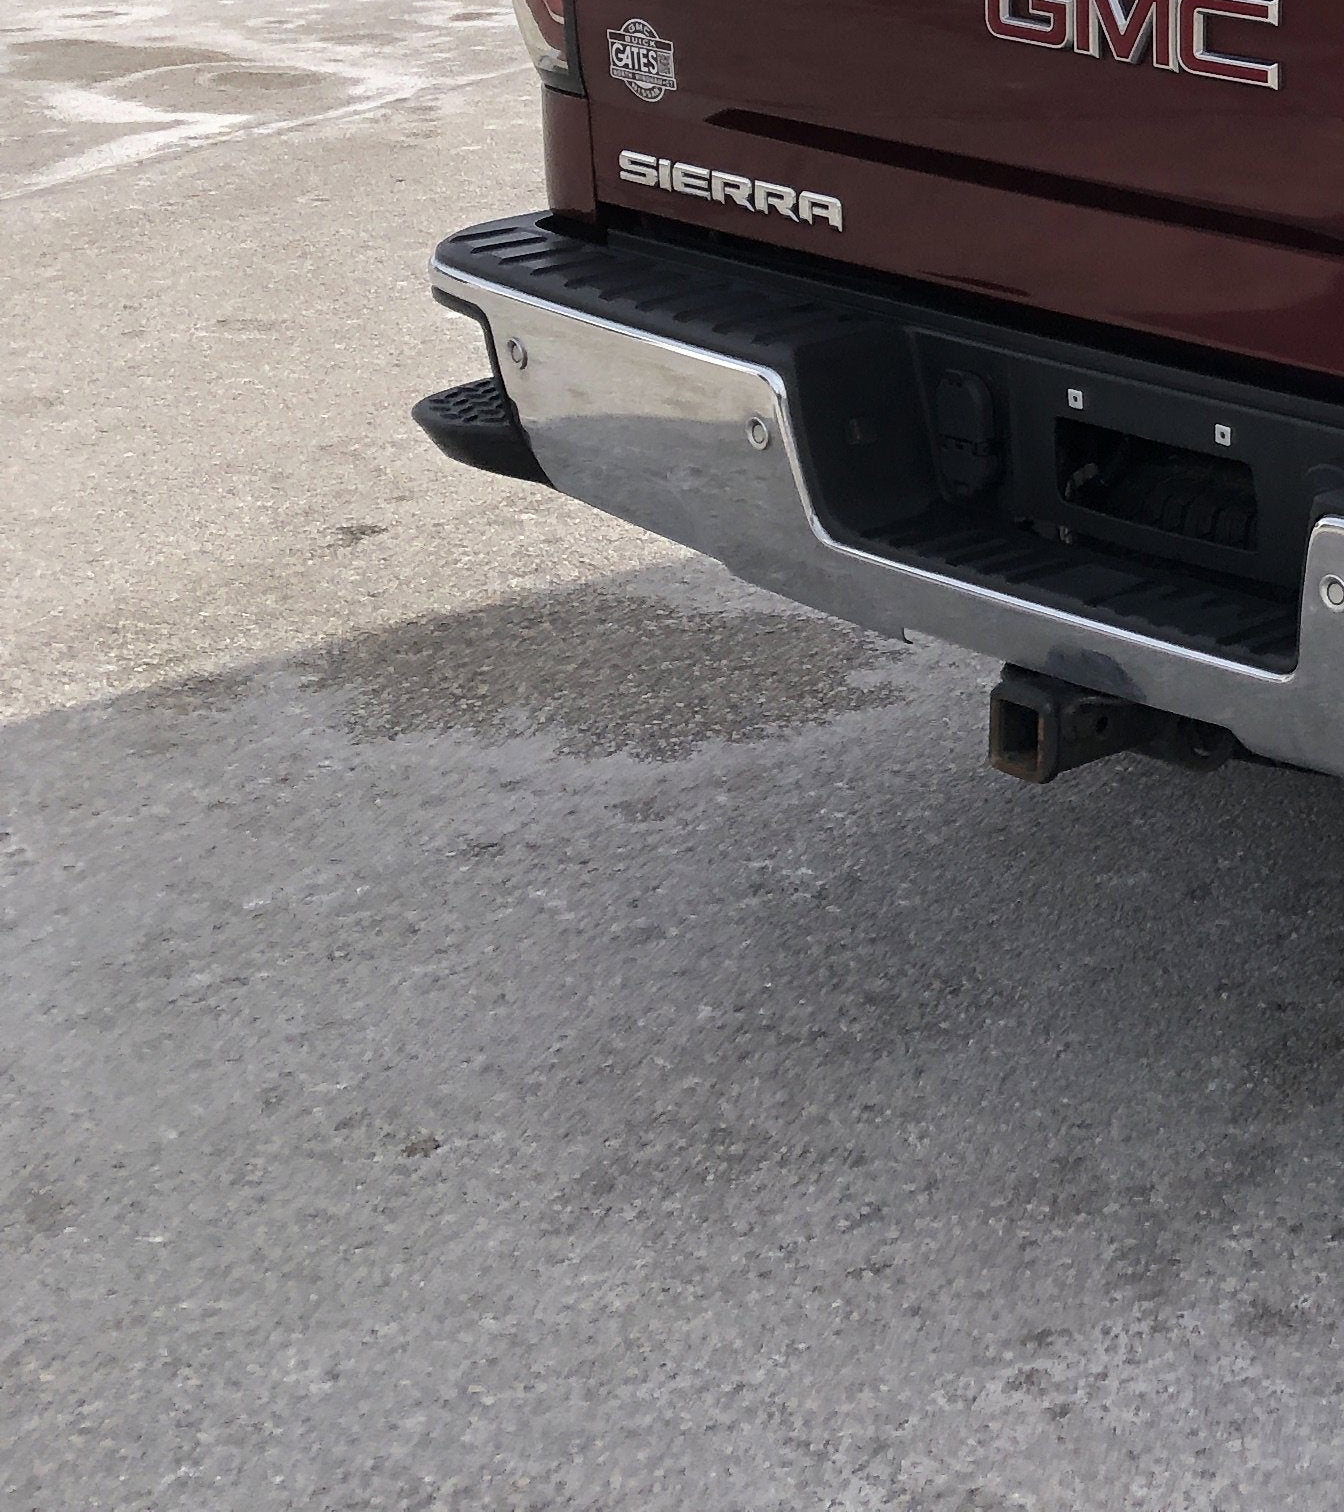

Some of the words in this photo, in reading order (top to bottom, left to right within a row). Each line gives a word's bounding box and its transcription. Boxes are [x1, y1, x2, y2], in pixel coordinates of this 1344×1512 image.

[624, 35, 656, 48] BUICK
[612, 42, 658, 74] GATES
[618, 150, 843, 233] SIERRA
